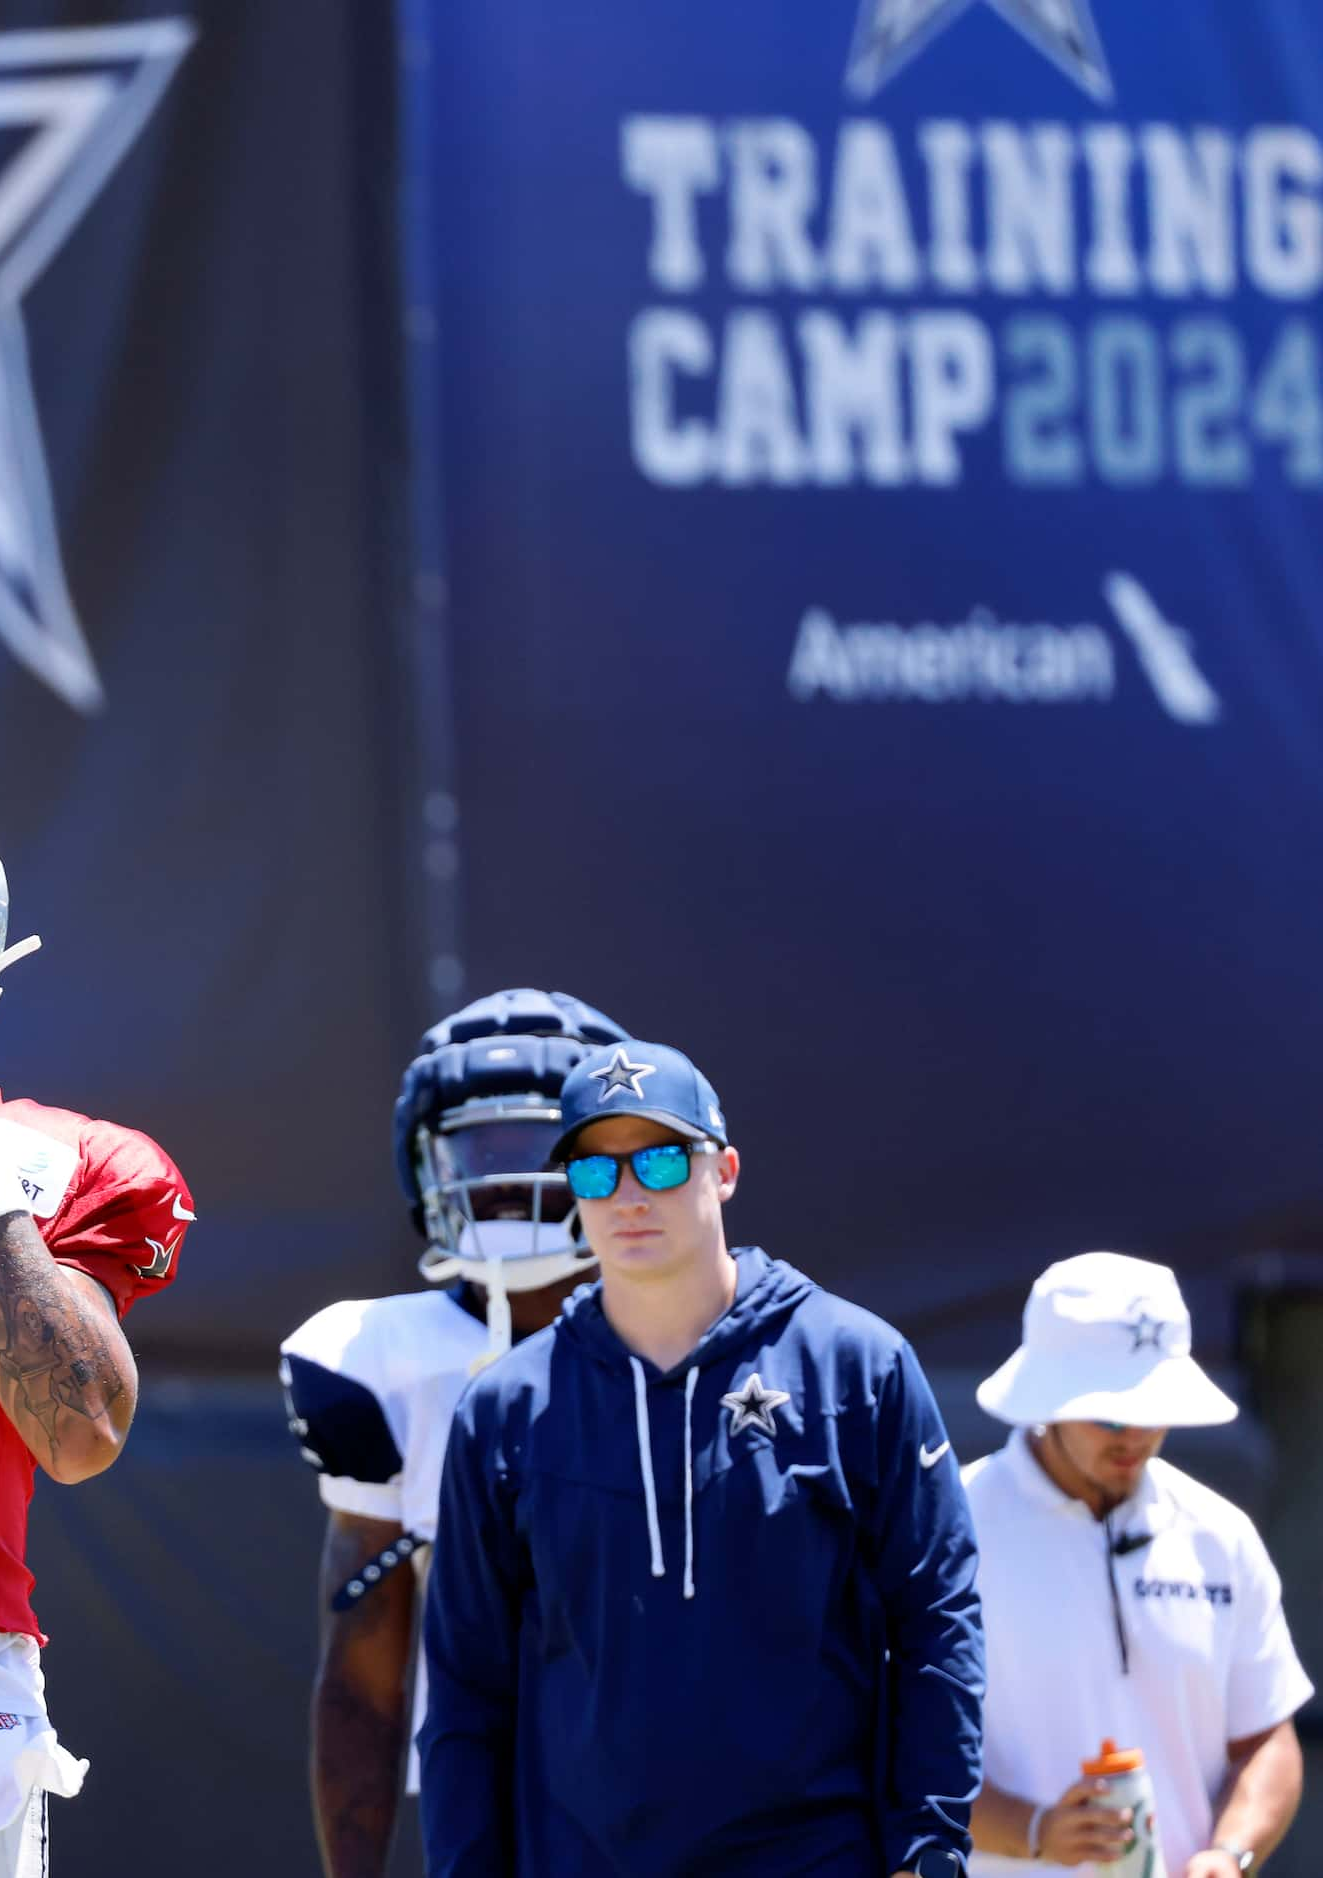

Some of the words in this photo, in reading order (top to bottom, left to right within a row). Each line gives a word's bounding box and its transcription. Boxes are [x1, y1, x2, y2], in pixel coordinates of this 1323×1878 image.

[622, 116, 1323, 296] TRAINING
[629, 308, 996, 488] CAMP
[1004, 314, 1323, 488] 2024
[790, 607, 1116, 701] American
